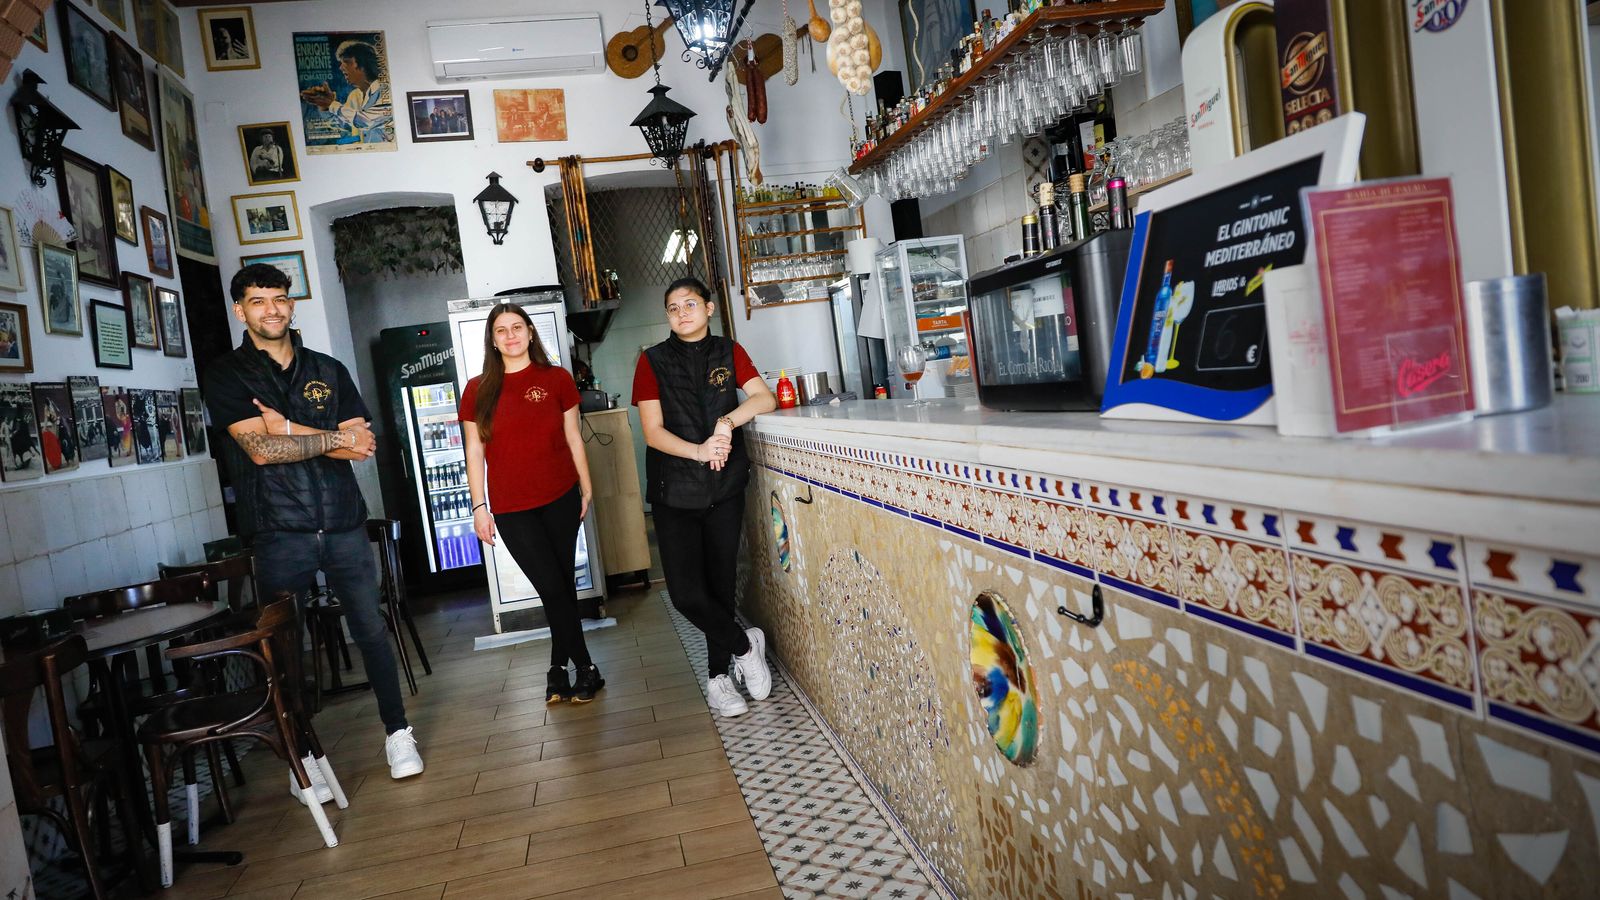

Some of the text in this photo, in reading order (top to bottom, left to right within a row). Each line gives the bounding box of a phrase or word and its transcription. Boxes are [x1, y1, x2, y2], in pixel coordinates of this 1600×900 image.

[296, 43, 330, 57] ENRIQUE
[298, 56, 332, 70] MORENTE
[1285, 88, 1331, 115] SELECTA
[1217, 206, 1291, 242] EL GINTONIC
[1204, 231, 1296, 268] MEDITERRÁNEO
[1211, 277, 1239, 297] LARIOS
[401, 347, 455, 379] SanMigue
[1246, 344, 1258, 363] €
